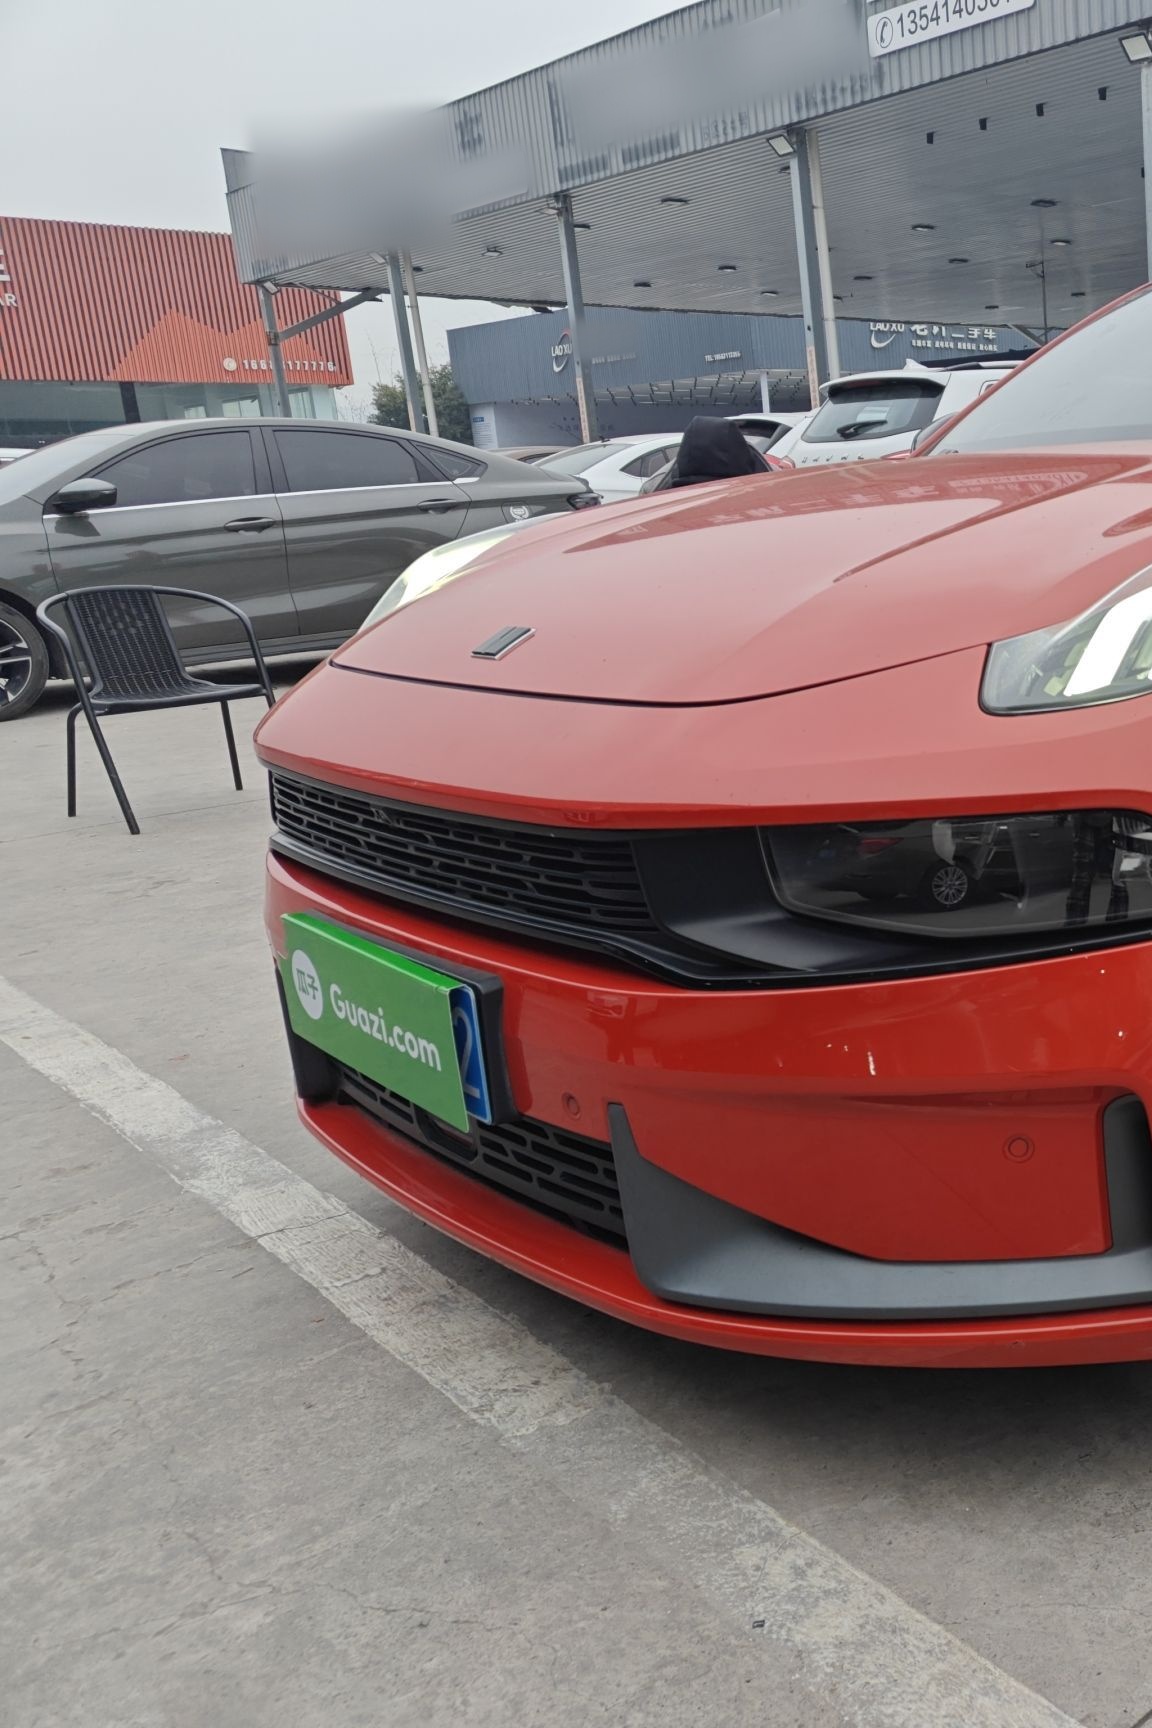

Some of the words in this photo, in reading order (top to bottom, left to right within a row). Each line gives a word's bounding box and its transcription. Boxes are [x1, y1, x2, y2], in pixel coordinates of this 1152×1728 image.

[897, 0, 1010, 38] 1354140
[296, 967, 319, 1001] 瓜子
[329, 983, 442, 1072] Guazi.com
